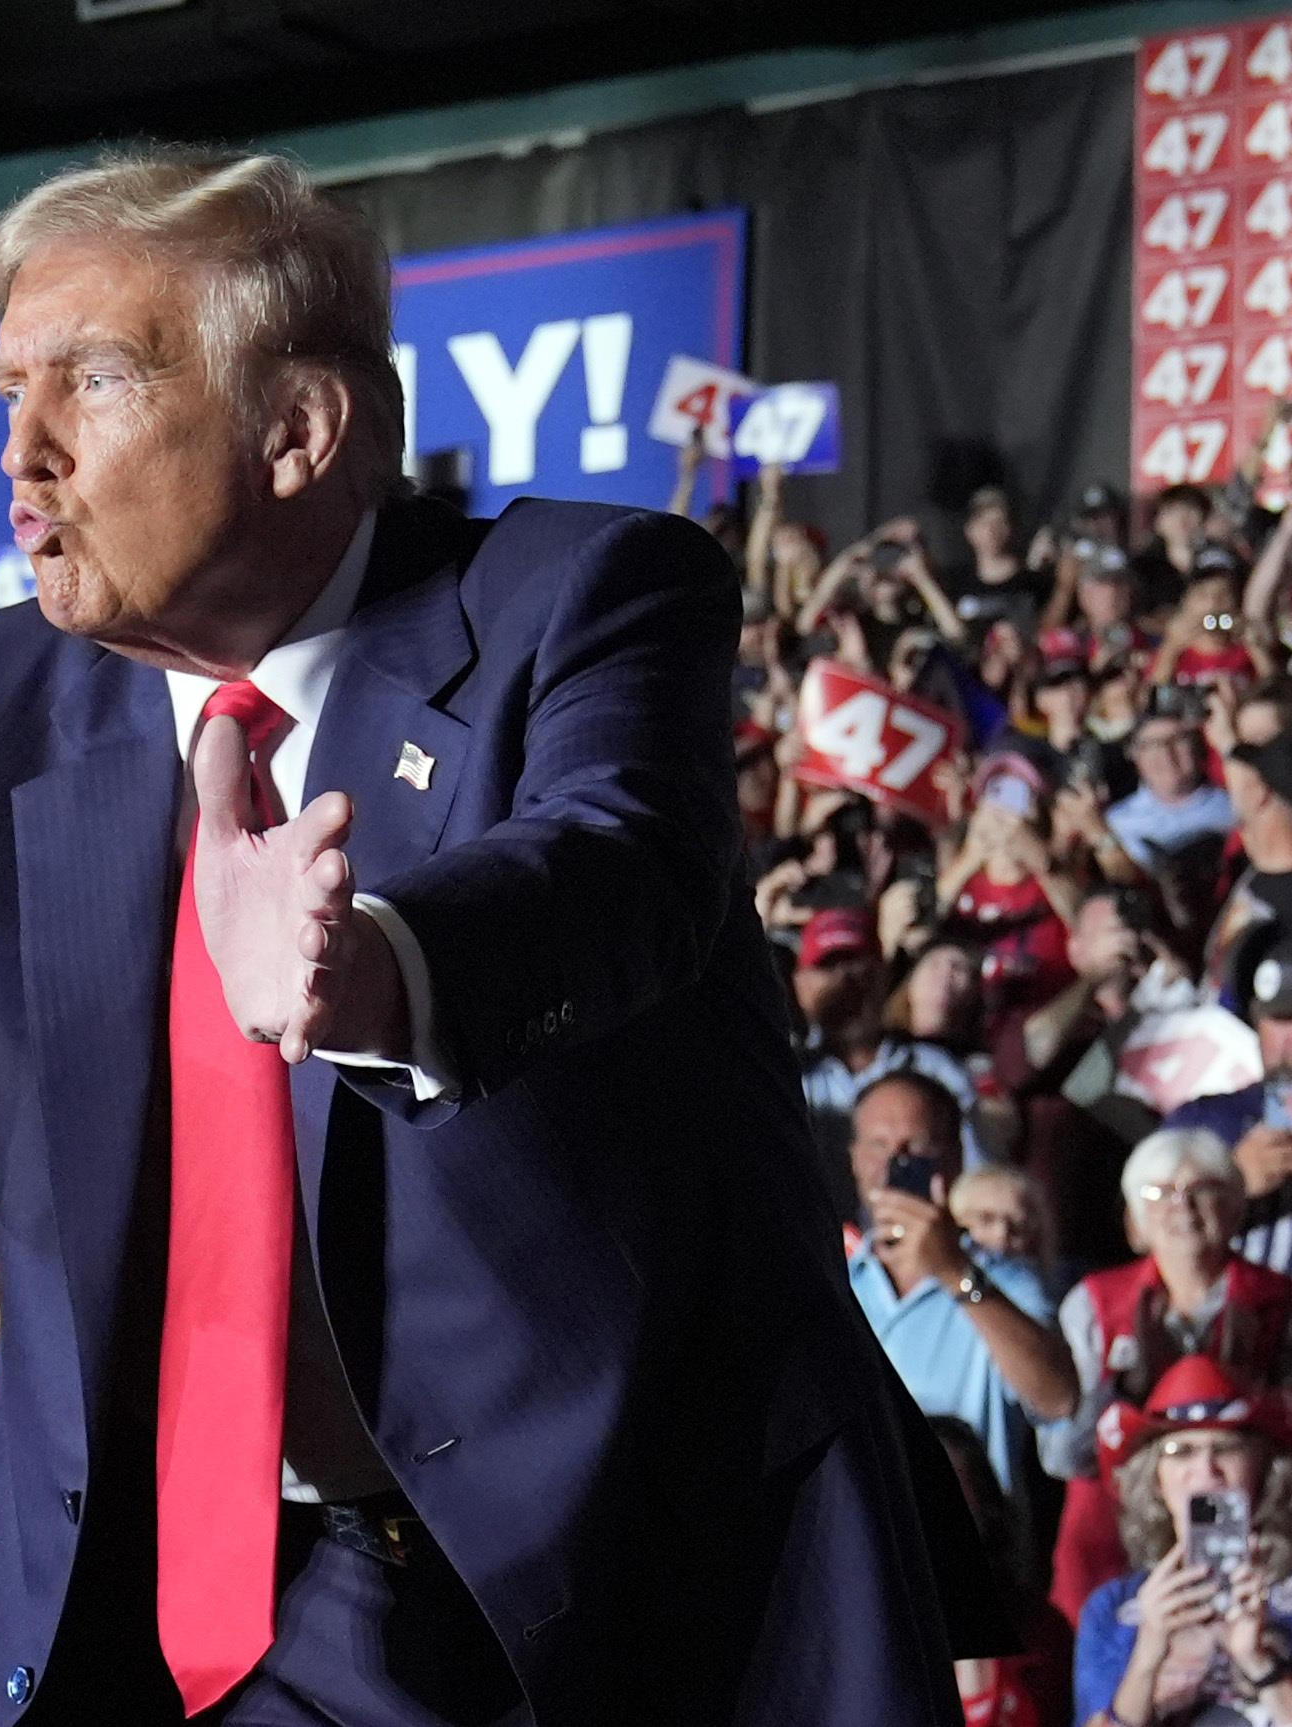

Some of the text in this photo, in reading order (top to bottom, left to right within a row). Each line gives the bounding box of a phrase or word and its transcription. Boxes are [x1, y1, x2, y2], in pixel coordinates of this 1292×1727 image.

[1145, 22, 1292, 99] 47 4
[1144, 102, 1292, 176] 47 4
[1143, 179, 1292, 253] 47 4
[1143, 256, 1292, 330] 47 4
[1142, 334, 1292, 406] 47 4
[1142, 419, 1226, 484] 47
[808, 690, 947, 790] 47
